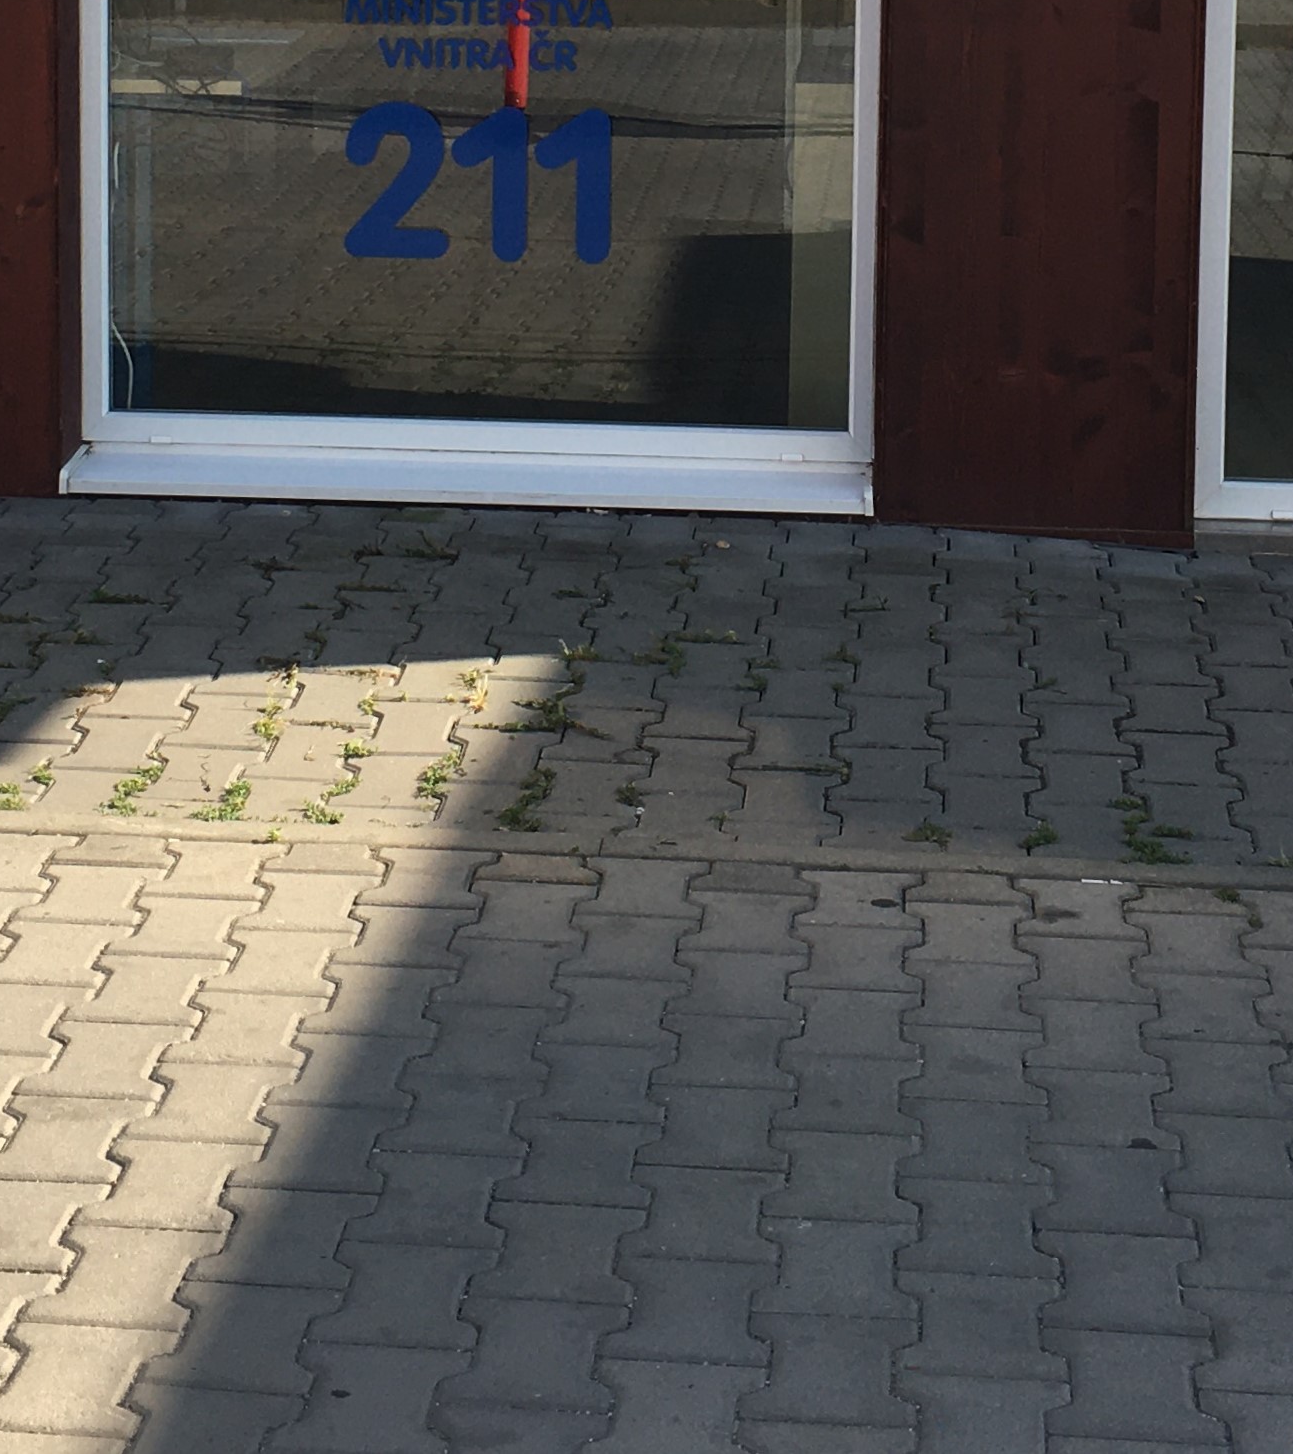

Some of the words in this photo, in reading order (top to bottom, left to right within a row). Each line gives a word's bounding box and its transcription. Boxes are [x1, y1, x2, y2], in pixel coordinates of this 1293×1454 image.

[378, 36, 516, 71] VNITRA
[528, 29, 578, 72] ČR
[344, 101, 612, 265] 211
